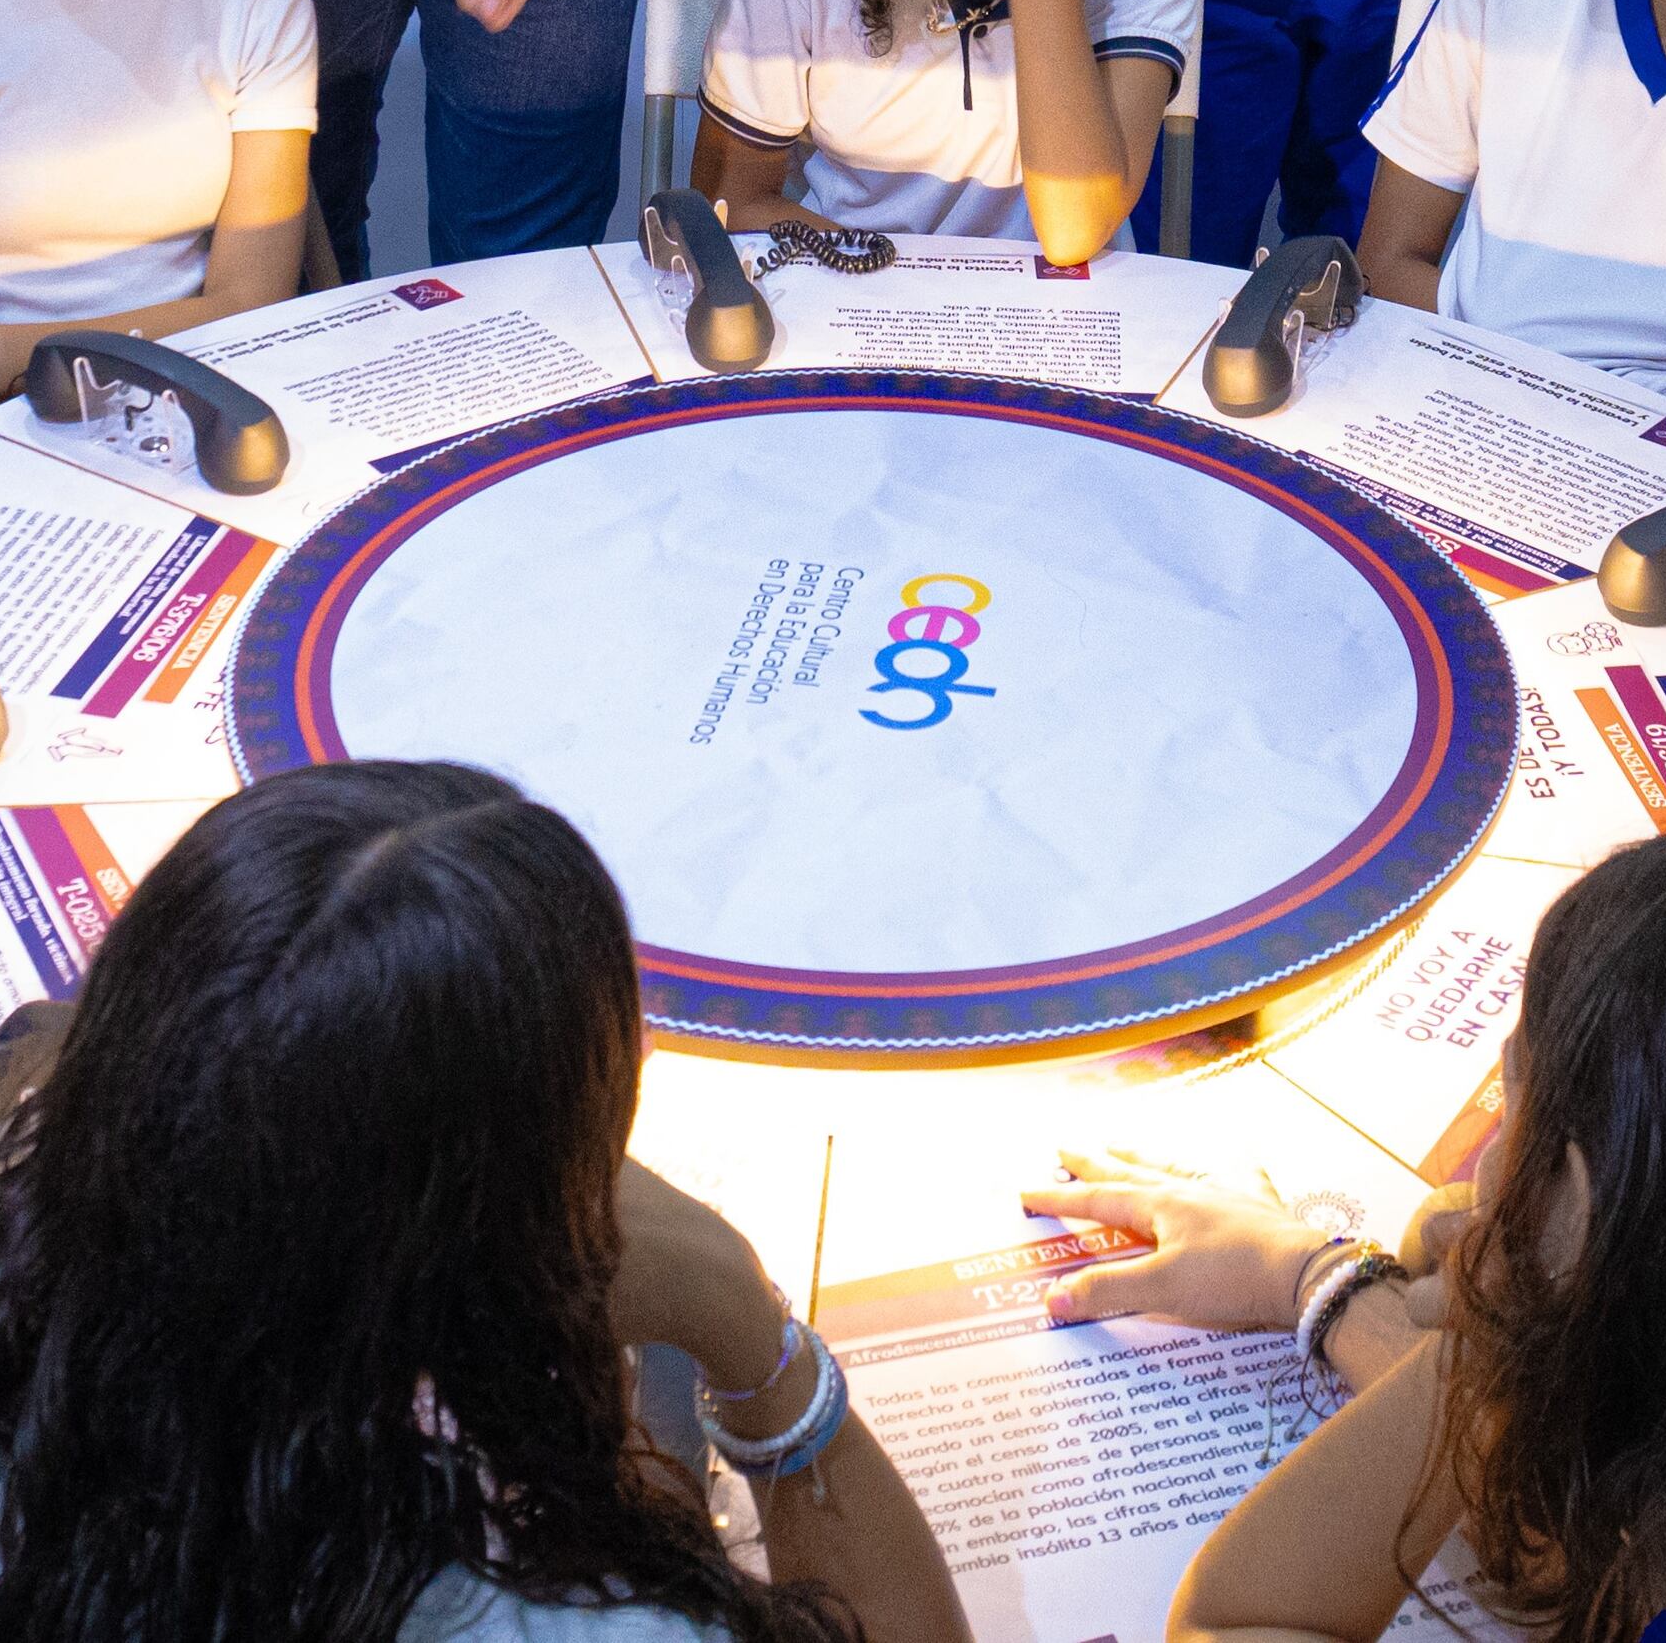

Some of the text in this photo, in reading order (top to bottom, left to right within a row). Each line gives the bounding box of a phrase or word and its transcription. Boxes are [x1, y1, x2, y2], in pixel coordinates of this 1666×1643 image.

[1409, 337, 1640, 428] Levanta bocina, oprime botón
[132, 592, 207, 663] T-376/06
[171, 593, 237, 669] SENTENCIA
[688, 558, 790, 745] en Derechos Humanos
[748, 561, 824, 705] para la Educación
[794, 566, 865, 687] Centro Cultural
[1525, 777, 1555, 798] ES
[1407, 945, 1454, 985] VOY
[1450, 931, 1476, 944] A
[1405, 936, 1513, 1043] QUEDARME
[1446, 1019, 1487, 1049] EN
[954, 1230, 1132, 1281] SENTENCIA
[1020, 1351, 1224, 1397] registradas forma
[1030, 1380, 1176, 1416] gobierno, pero,
[1068, 1395, 1191, 1426] oficial revela
[1089, 1403, 1250, 1443] 2005, país
[1011, 1419, 1261, 1478] millones personas que
[966, 1485, 1250, 1549] embargo, cifras oficiales
[1027, 1463, 1248, 1518] población nacional en
[1016, 1519, 1178, 1560] insólito 13 años
